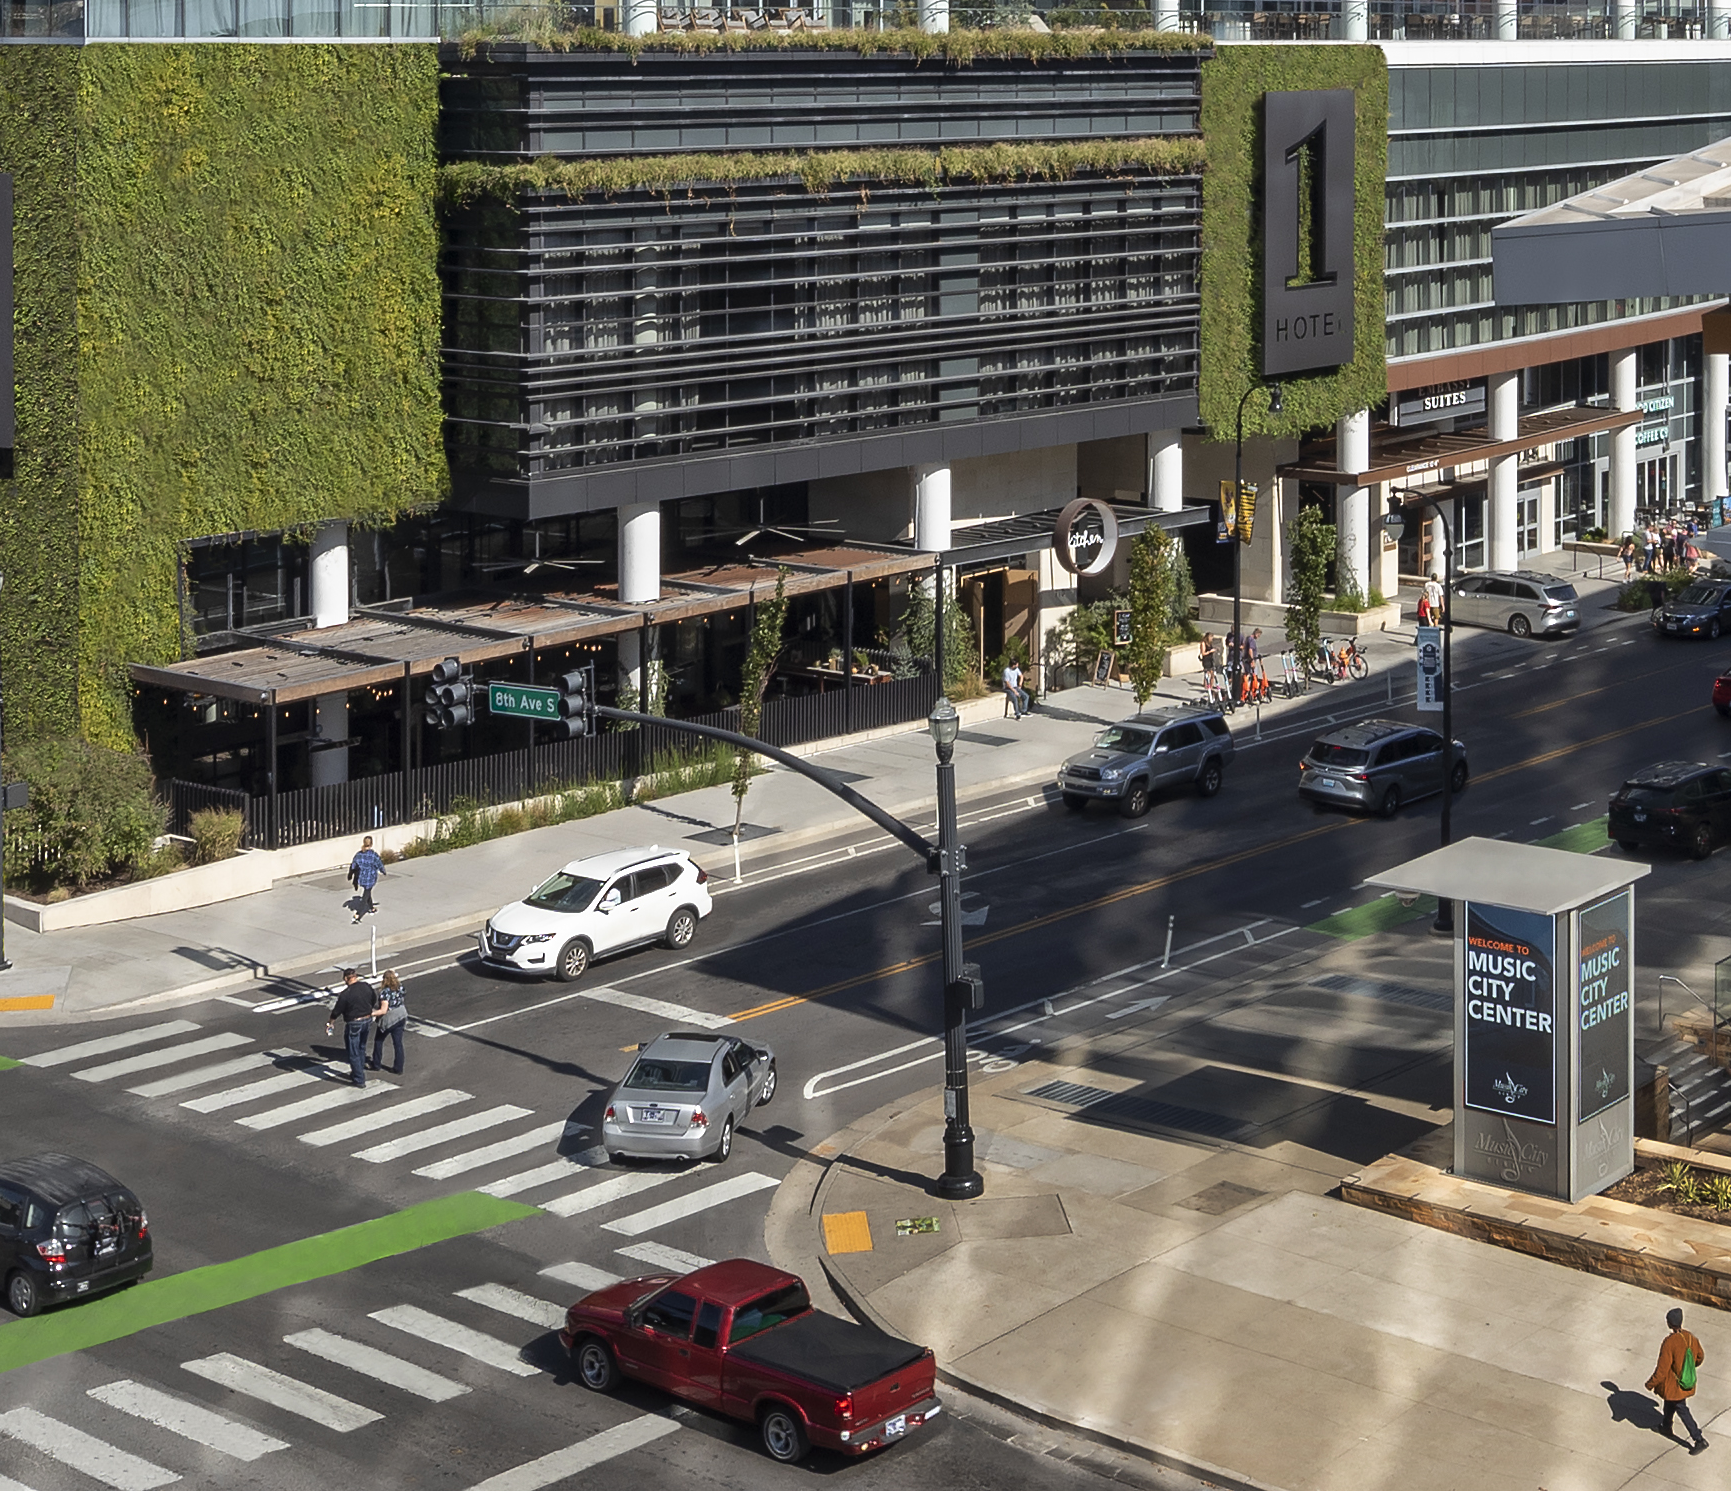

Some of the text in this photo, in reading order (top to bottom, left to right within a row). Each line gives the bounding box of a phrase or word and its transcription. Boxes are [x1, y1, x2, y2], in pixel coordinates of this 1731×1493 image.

[1424, 391, 1467, 410] SUITES
[495, 692, 555, 712] 8th Ave S
[1469, 936, 1529, 956] WELCOME TO
[1469, 950, 1536, 981] MUSIC
[1581, 946, 1620, 983] MUSIC
[1469, 975, 1515, 1001] CITY
[1581, 976, 1608, 1007] CITY
[1469, 999, 1552, 1033] CENTER
[1581, 991, 1629, 1031] CENTER
